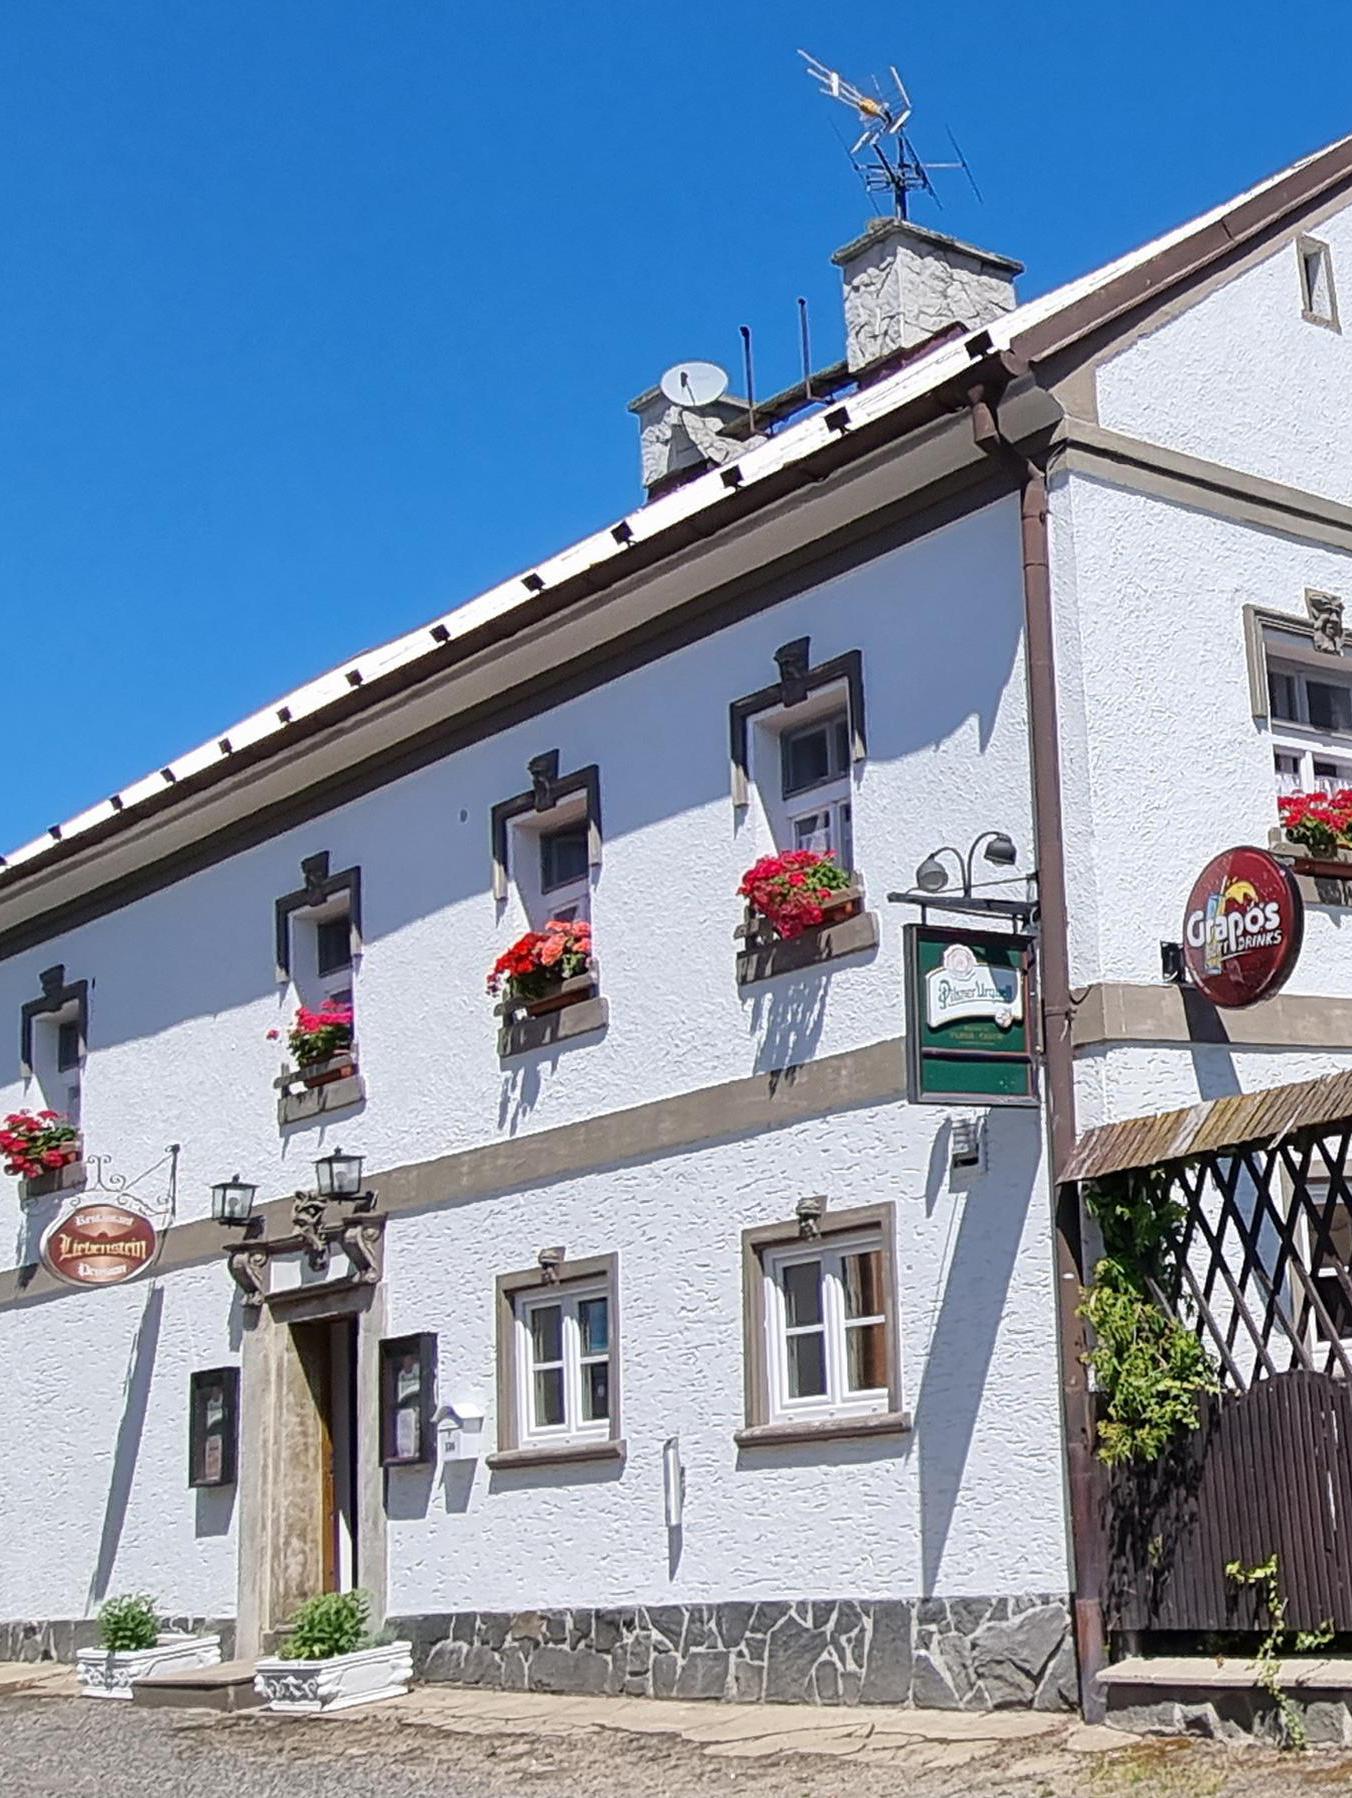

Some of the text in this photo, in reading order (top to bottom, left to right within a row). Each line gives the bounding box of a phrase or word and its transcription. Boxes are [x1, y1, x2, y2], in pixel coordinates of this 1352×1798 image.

[1187, 902, 1281, 953] Grapos
[1237, 930, 1283, 951] DRINKS
[59, 1233, 146, 1261] Liebenstein
